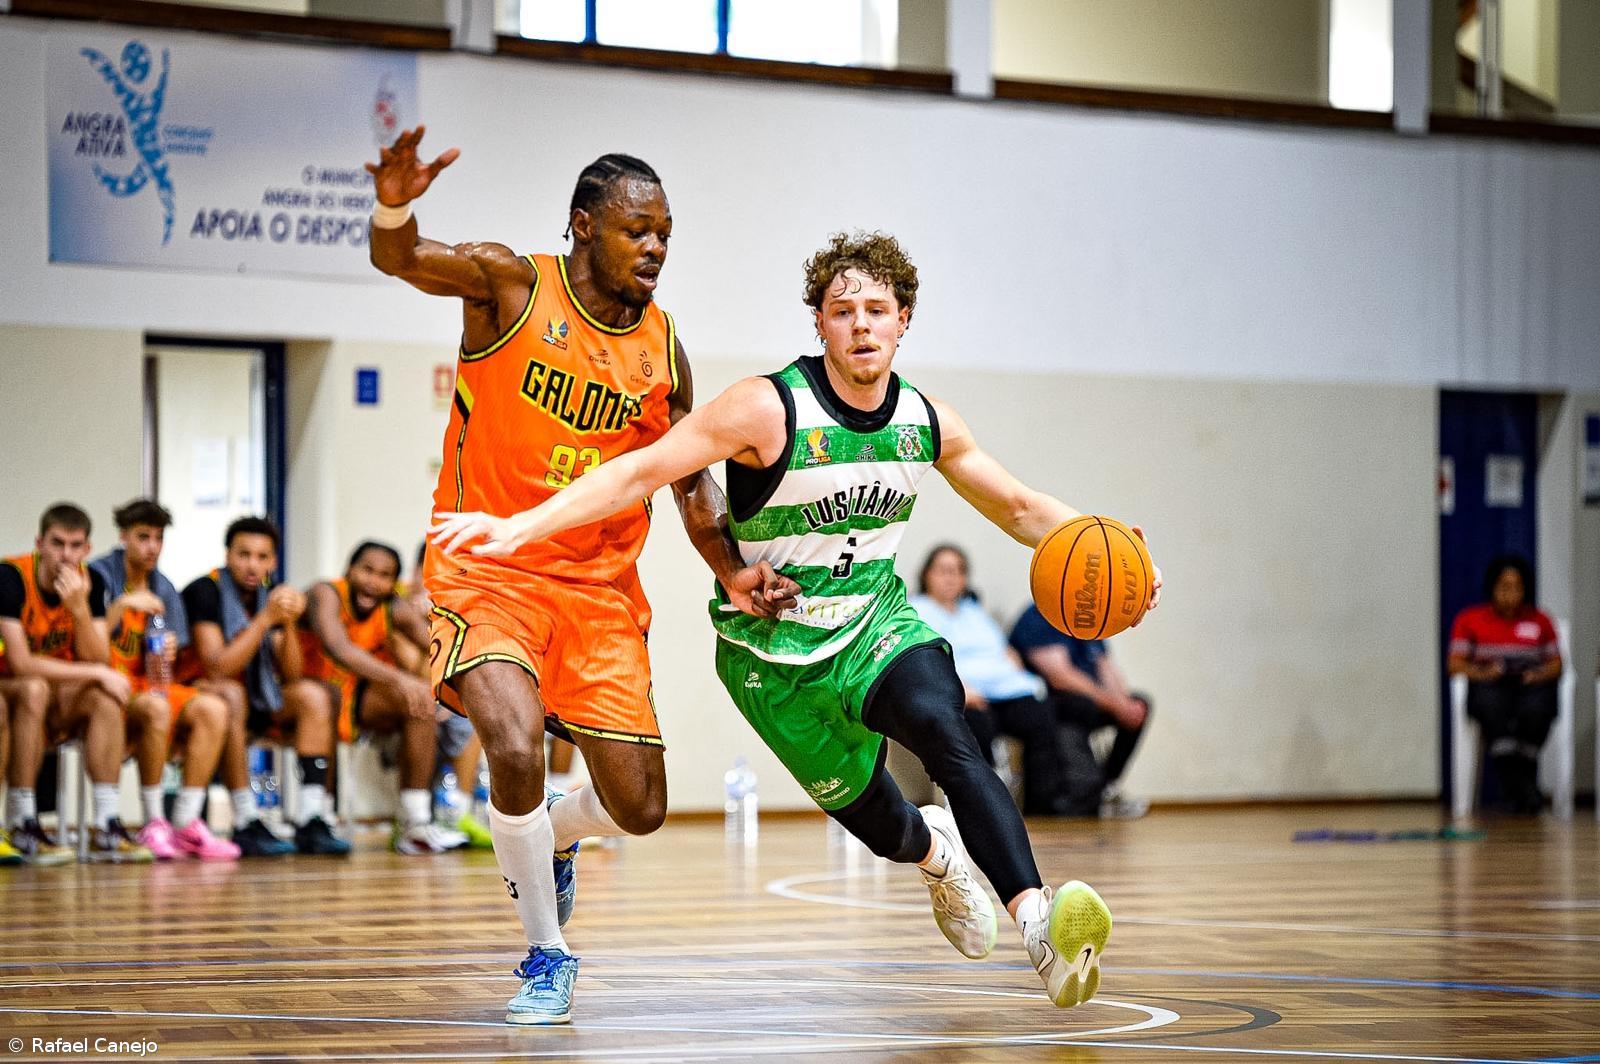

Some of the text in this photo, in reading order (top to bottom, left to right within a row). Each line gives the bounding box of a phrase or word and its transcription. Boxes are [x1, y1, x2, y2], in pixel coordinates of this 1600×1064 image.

[61, 111, 126, 134] ANGRA
[75, 136, 126, 158] ATIVA
[190, 208, 369, 247] APOIA O DESPO
[1074, 552, 1101, 629] Wilson
